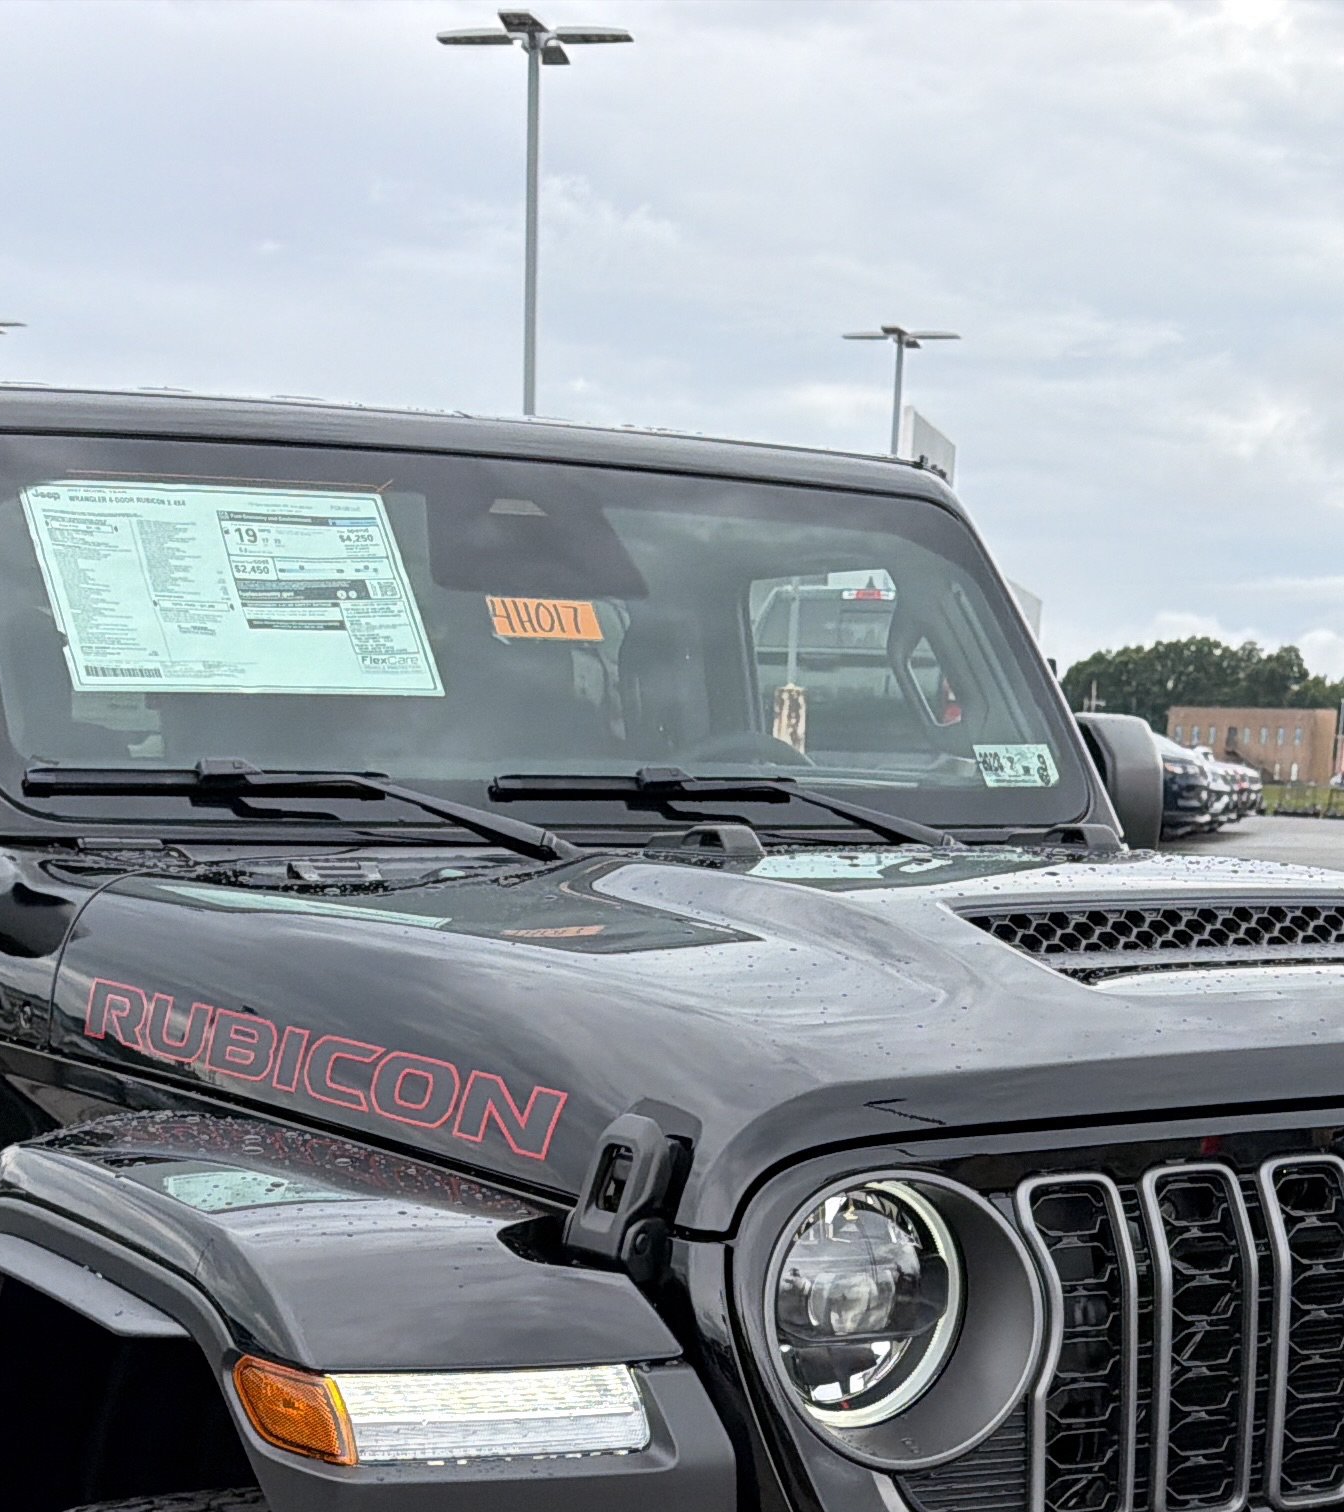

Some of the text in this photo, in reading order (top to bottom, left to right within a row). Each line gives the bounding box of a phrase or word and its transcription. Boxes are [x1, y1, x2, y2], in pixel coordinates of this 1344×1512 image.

[31, 489, 60, 501] Jeep
[234, 527, 257, 543] 19
[339, 534, 374, 544] $4,250
[234, 564, 270, 575] $2,450
[361, 655, 419, 665] FlexCare
[84, 977, 569, 1161] RUBICON
